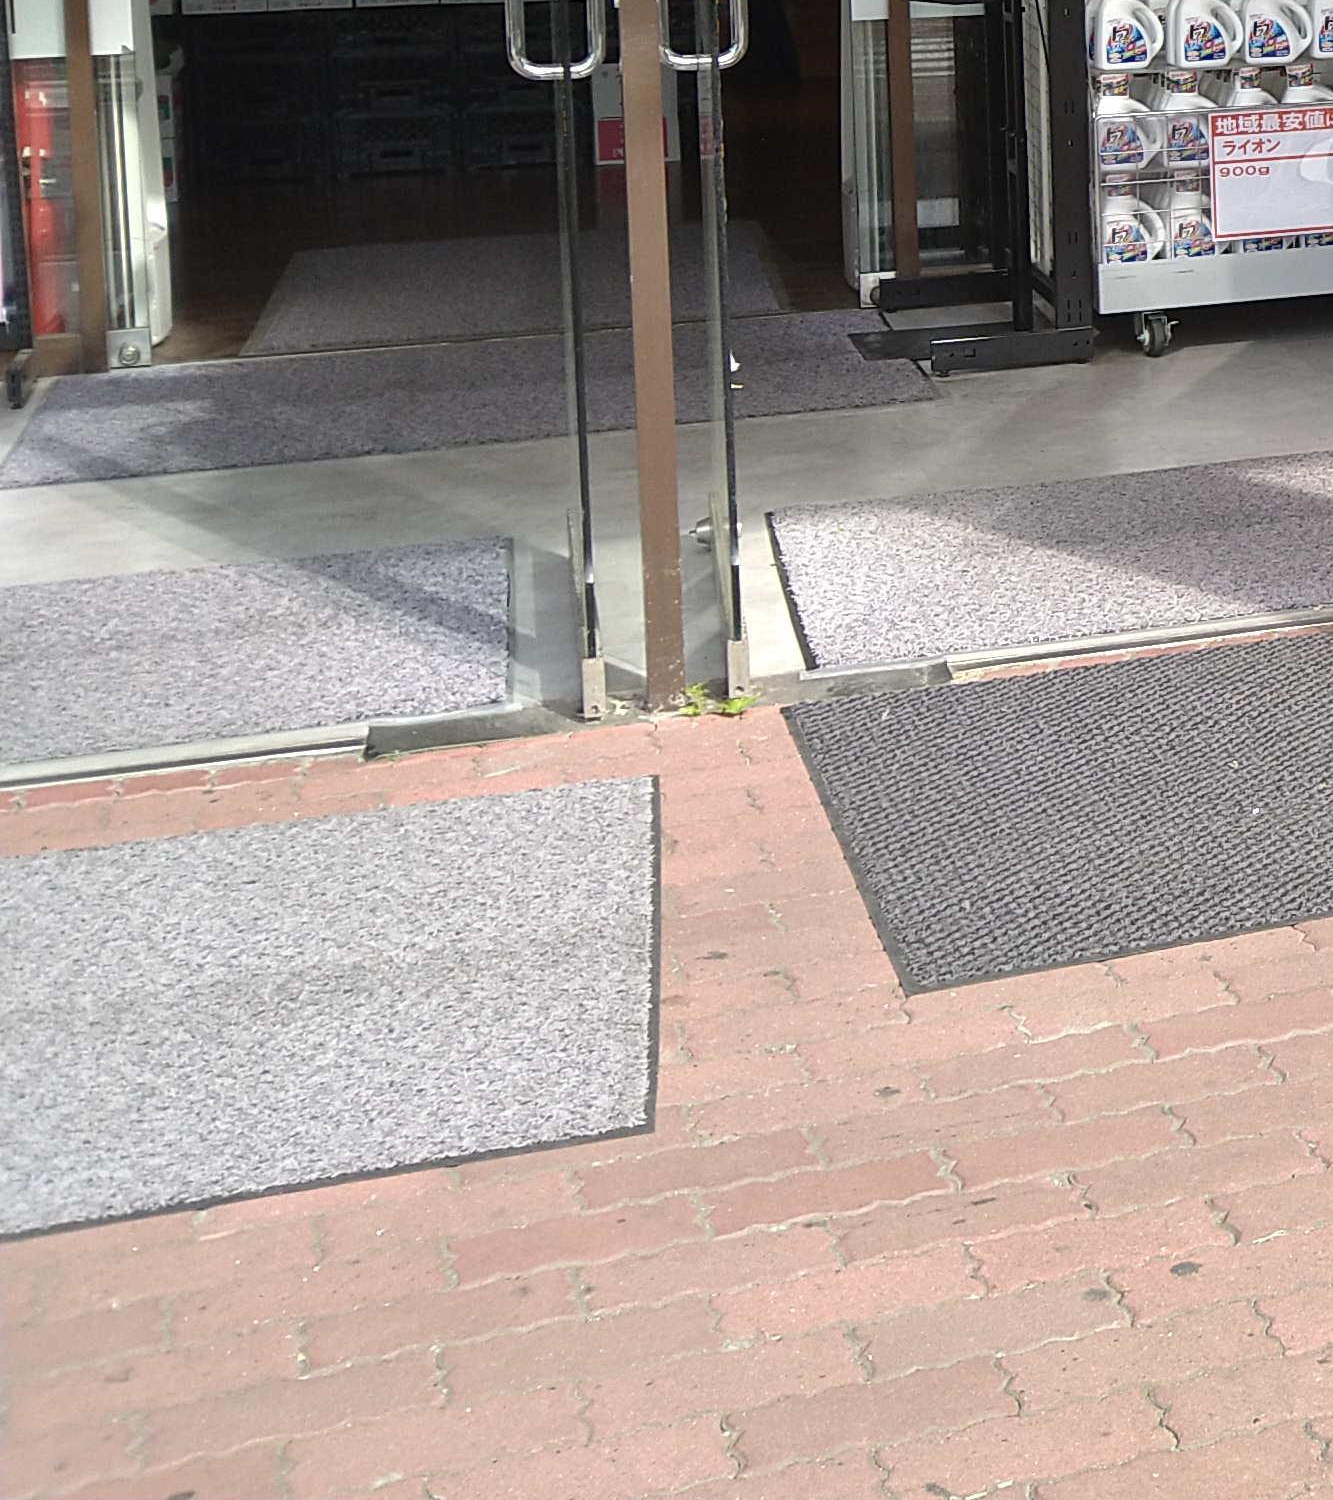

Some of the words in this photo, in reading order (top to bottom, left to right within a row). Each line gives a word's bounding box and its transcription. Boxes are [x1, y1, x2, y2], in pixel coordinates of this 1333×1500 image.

[1222, 139, 1281, 156] ライオン
[1219, 165, 1270, 177] 900g
